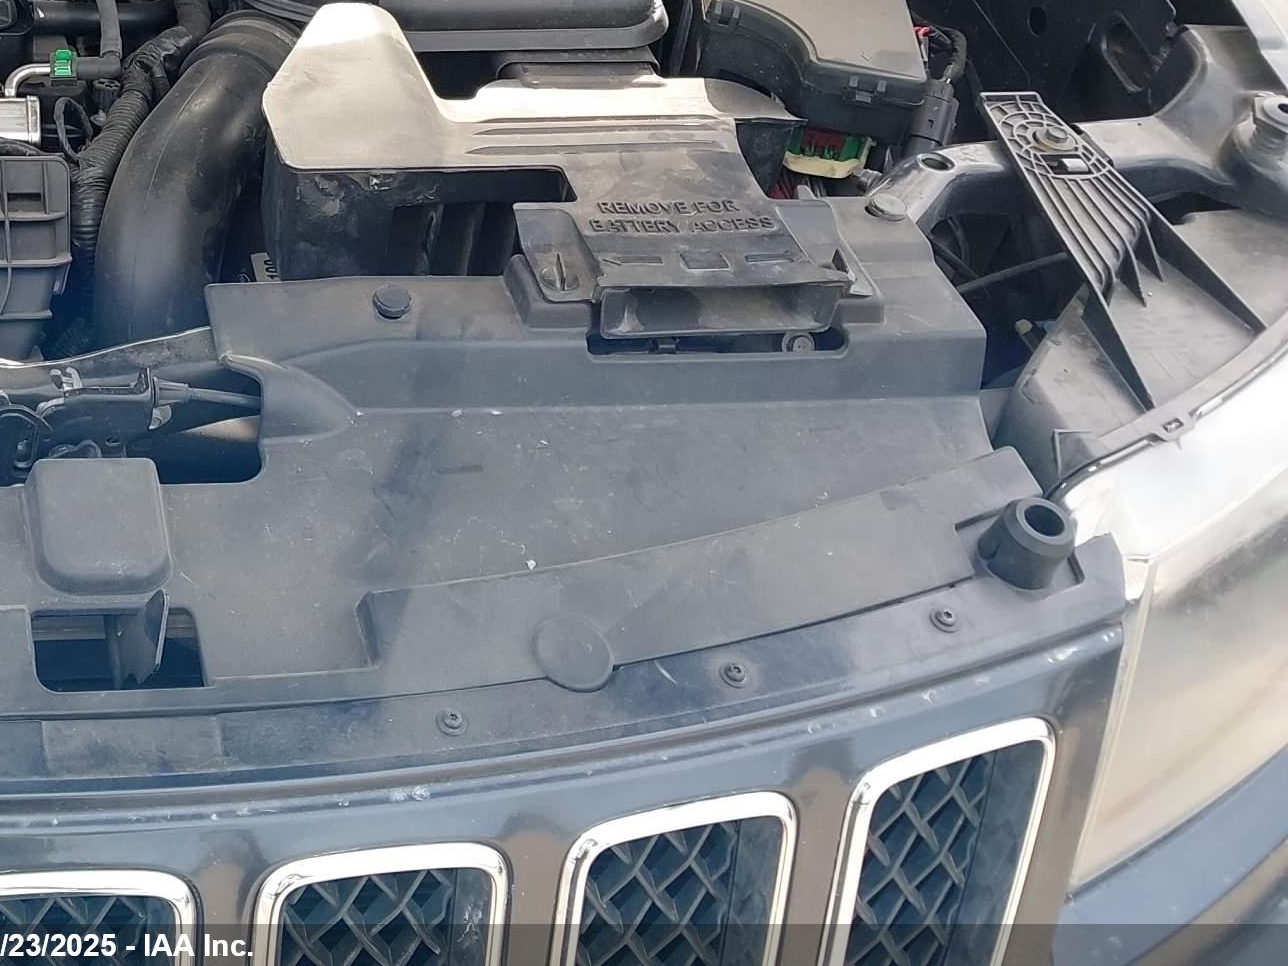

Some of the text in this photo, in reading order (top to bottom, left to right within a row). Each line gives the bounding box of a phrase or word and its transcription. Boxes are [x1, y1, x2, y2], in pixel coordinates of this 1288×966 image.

[596, 199, 741, 215] REMOVE FOR
[589, 216, 777, 234] BATTERY ACCESS
